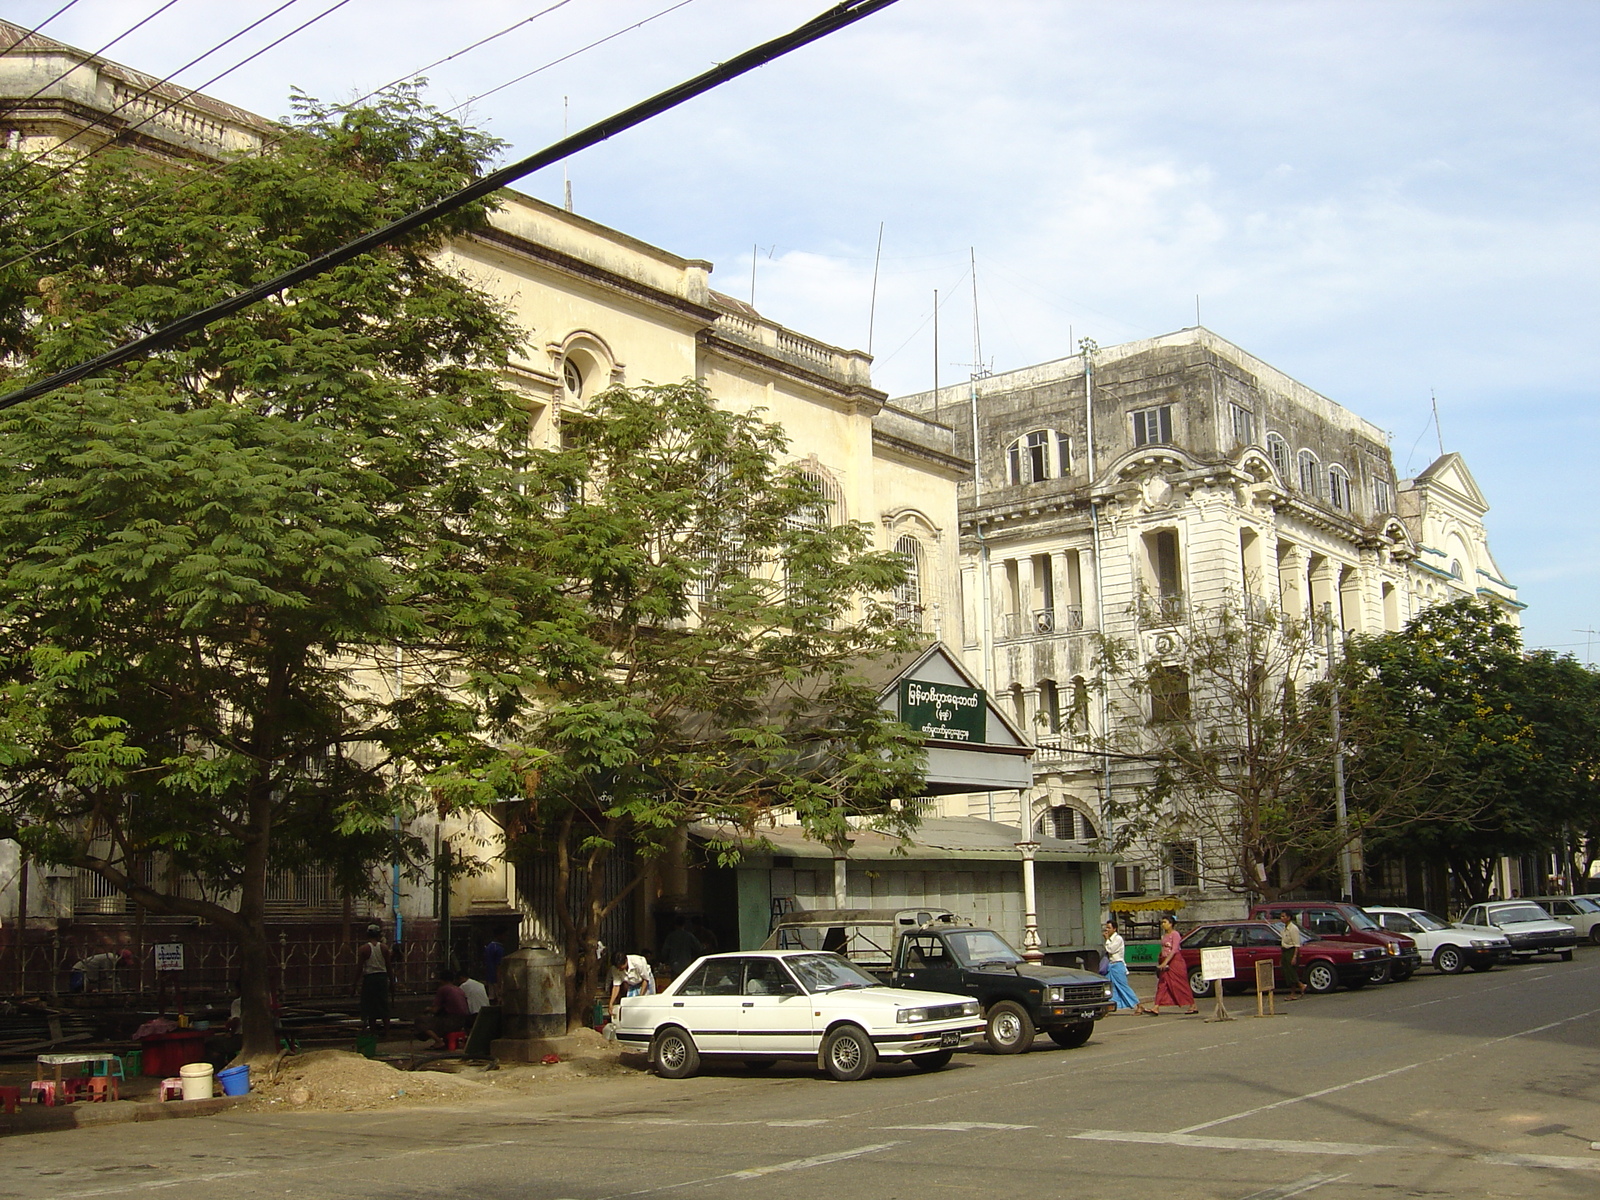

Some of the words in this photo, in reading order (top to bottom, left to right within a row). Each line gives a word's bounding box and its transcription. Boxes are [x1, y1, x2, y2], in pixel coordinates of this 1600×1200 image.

[909, 684, 977, 710] မြန်မာ့စီးပွားရေးဘဏ်
